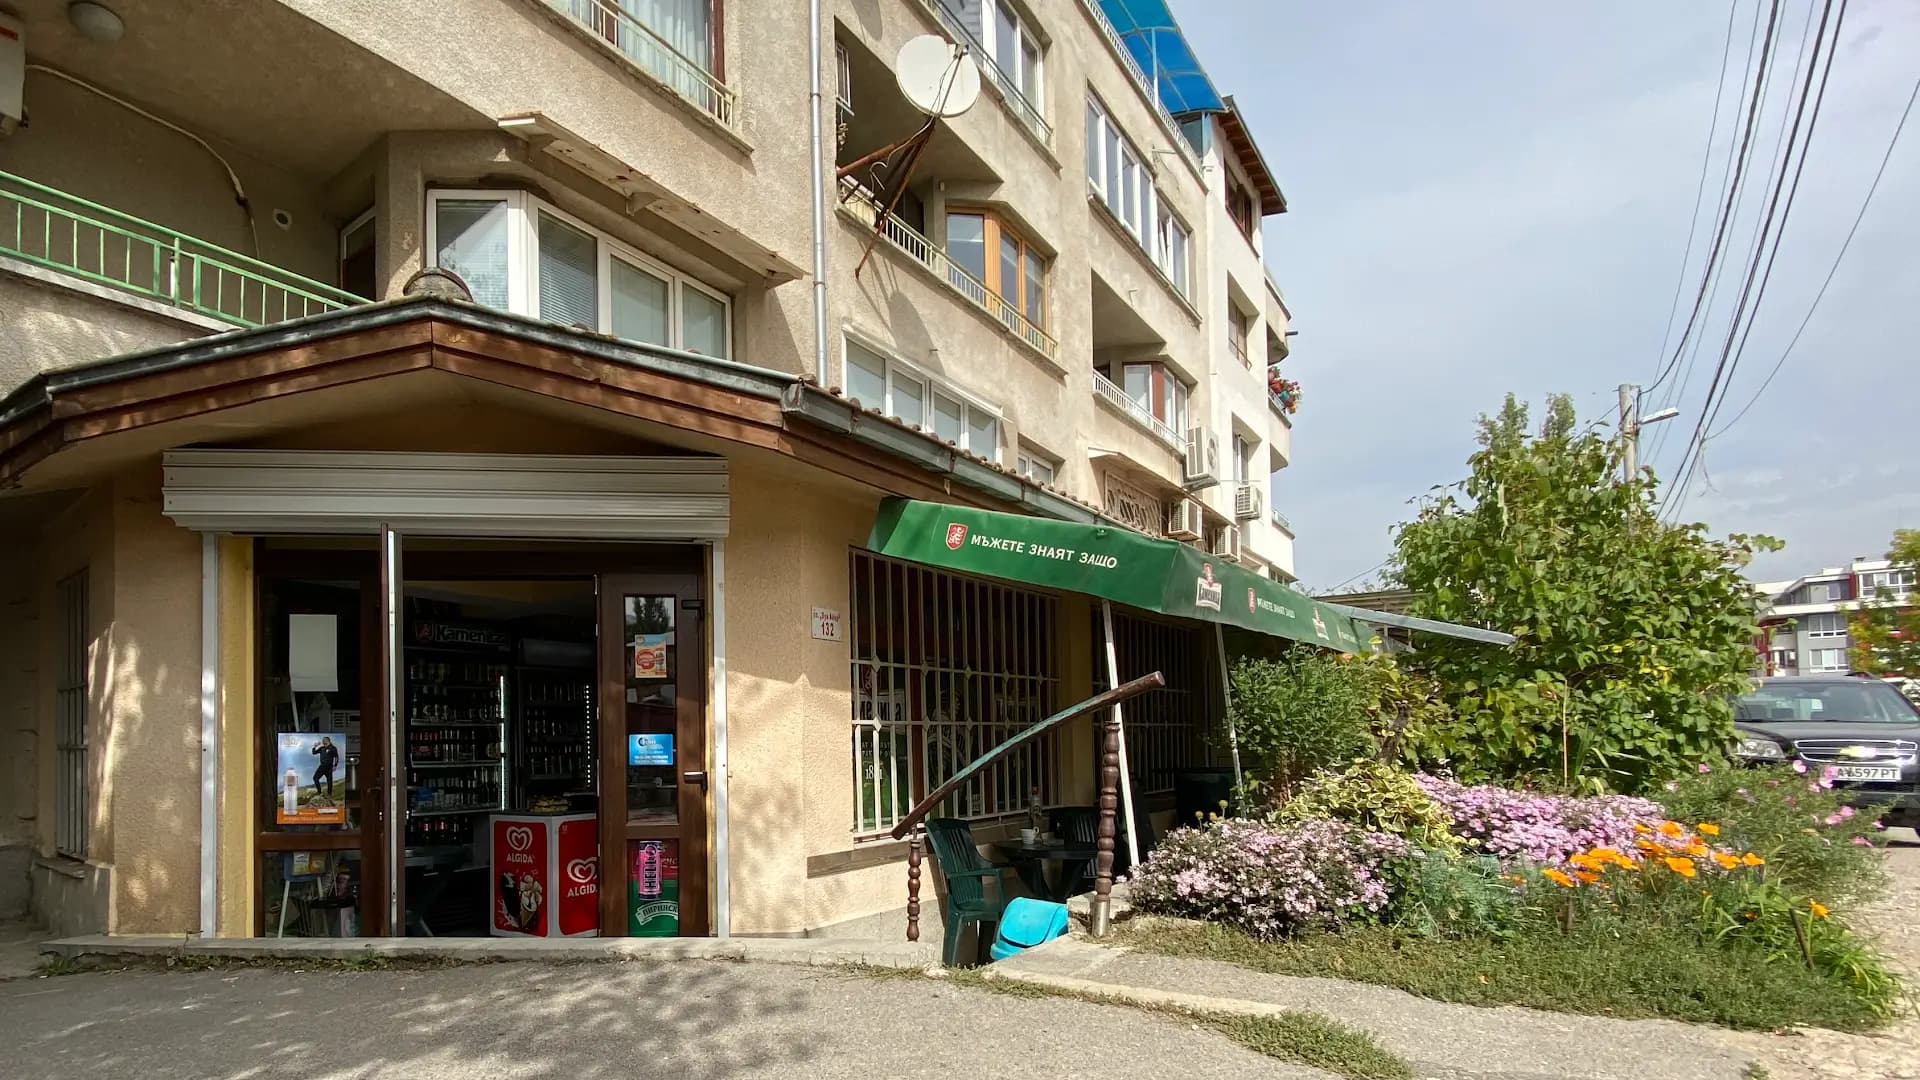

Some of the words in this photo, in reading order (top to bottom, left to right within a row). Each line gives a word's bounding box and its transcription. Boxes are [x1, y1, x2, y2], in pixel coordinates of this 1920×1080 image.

[971, 534, 1025, 553] МЪЖЕТЕ
[1028, 544, 1074, 561] ЗНАЯТ
[1079, 552, 1117, 568] ЗАЩО
[822, 621, 834, 637] 132
[865, 765, 883, 779] 181
[1881, 769, 1897, 778] PT
[506, 853, 533, 864] ALGIDA
[567, 884, 597, 897] ALGID
